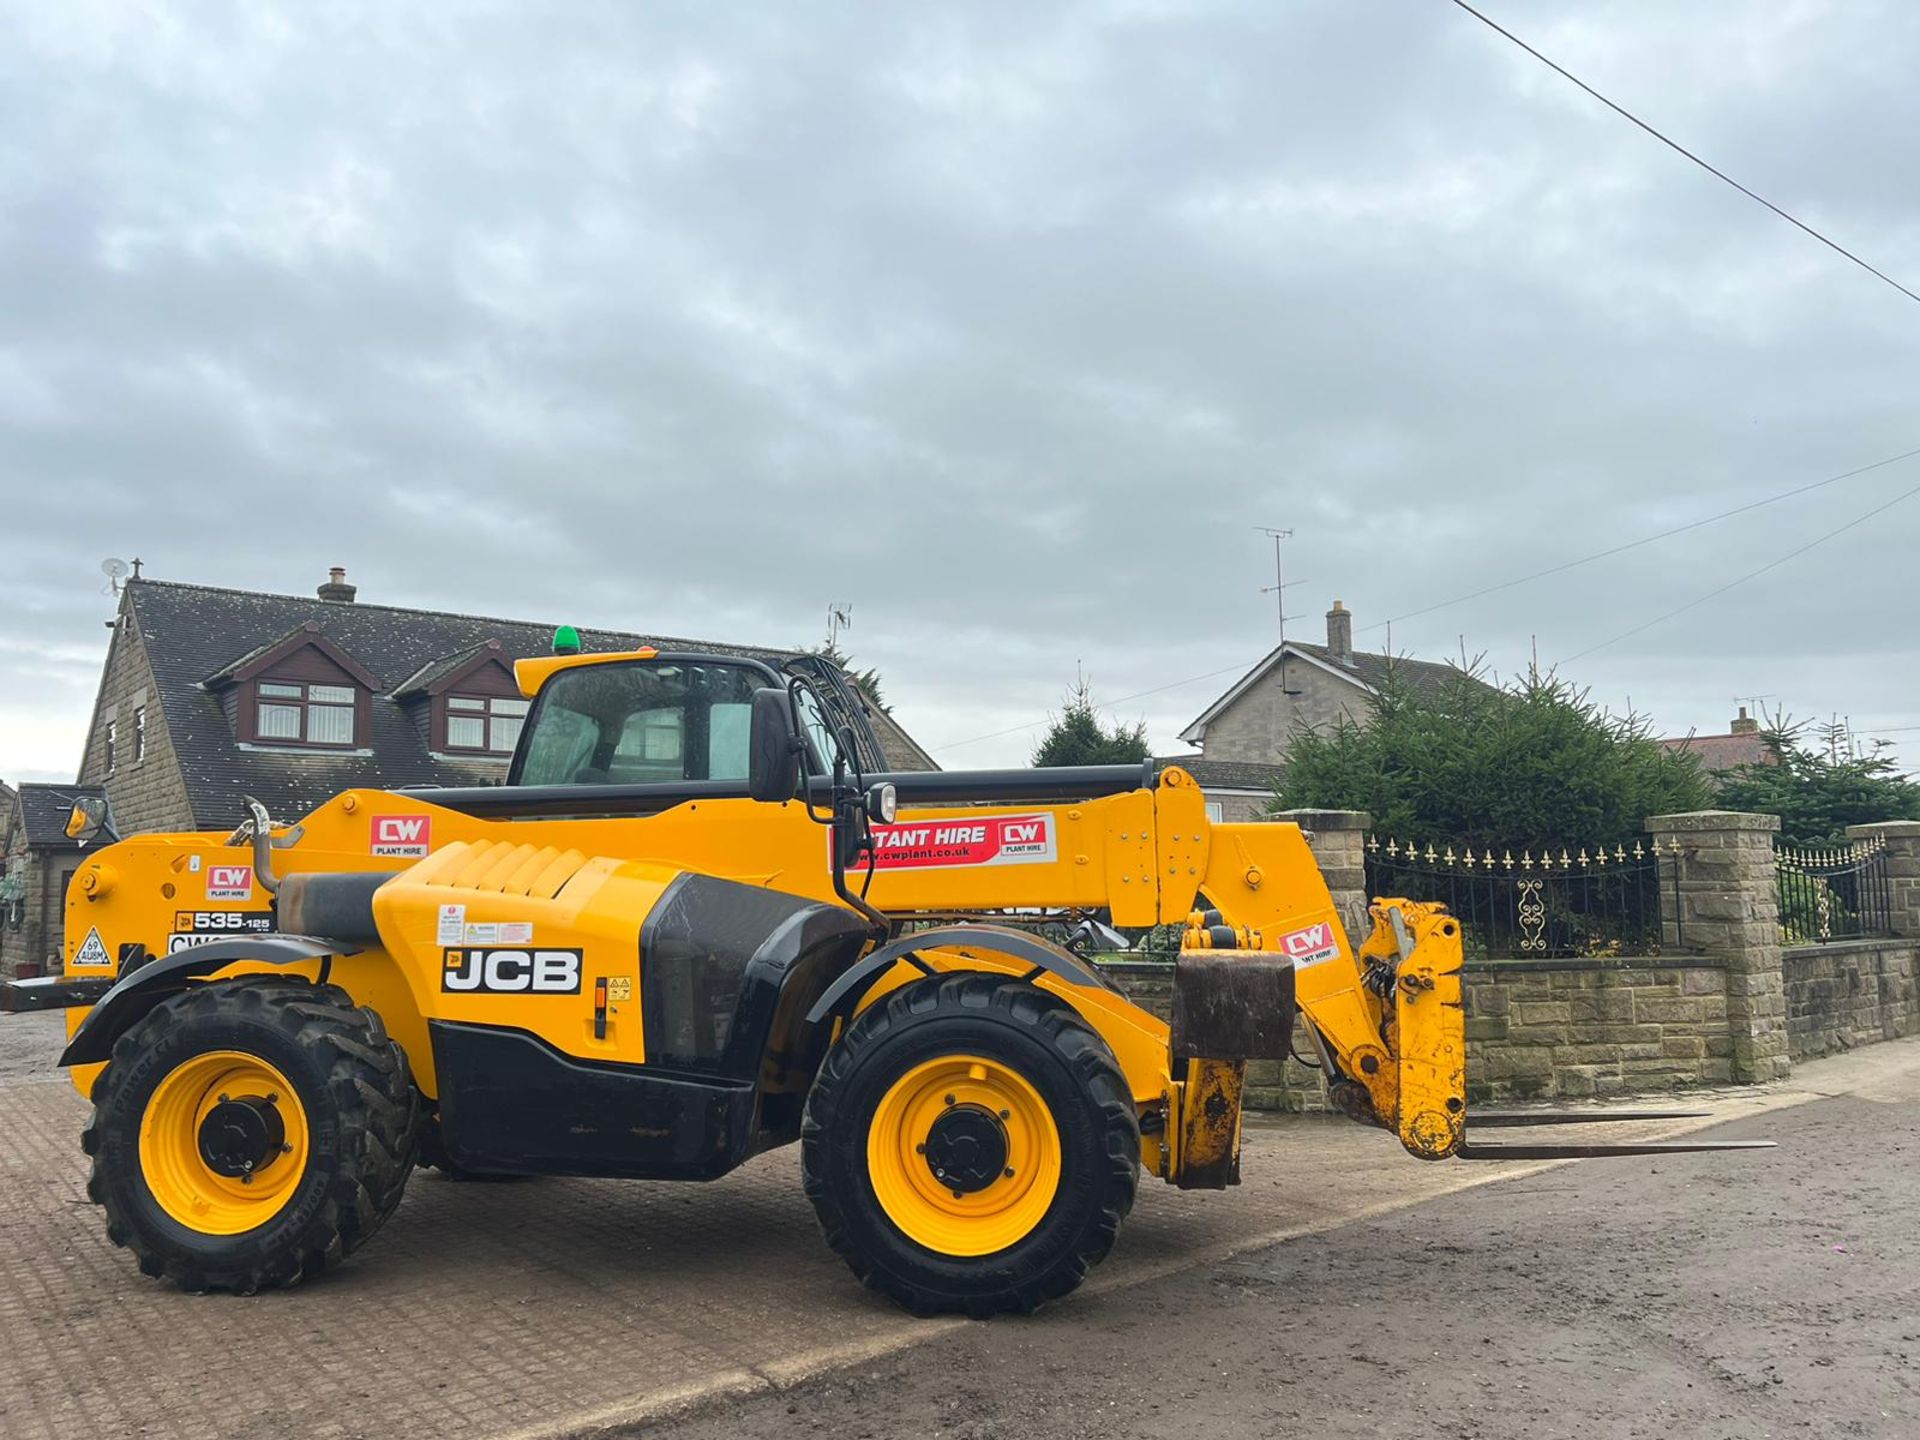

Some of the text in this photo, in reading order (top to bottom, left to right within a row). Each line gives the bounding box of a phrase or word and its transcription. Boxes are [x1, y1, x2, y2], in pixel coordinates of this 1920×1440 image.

[379, 820, 423, 841] CW
[934, 826, 986, 845] HIRE
[1004, 824, 1038, 842] CW
[376, 847, 401, 855] PLANT
[213, 869, 247, 886] CW
[1286, 926, 1323, 954] CW
[445, 951, 579, 991] JCB
